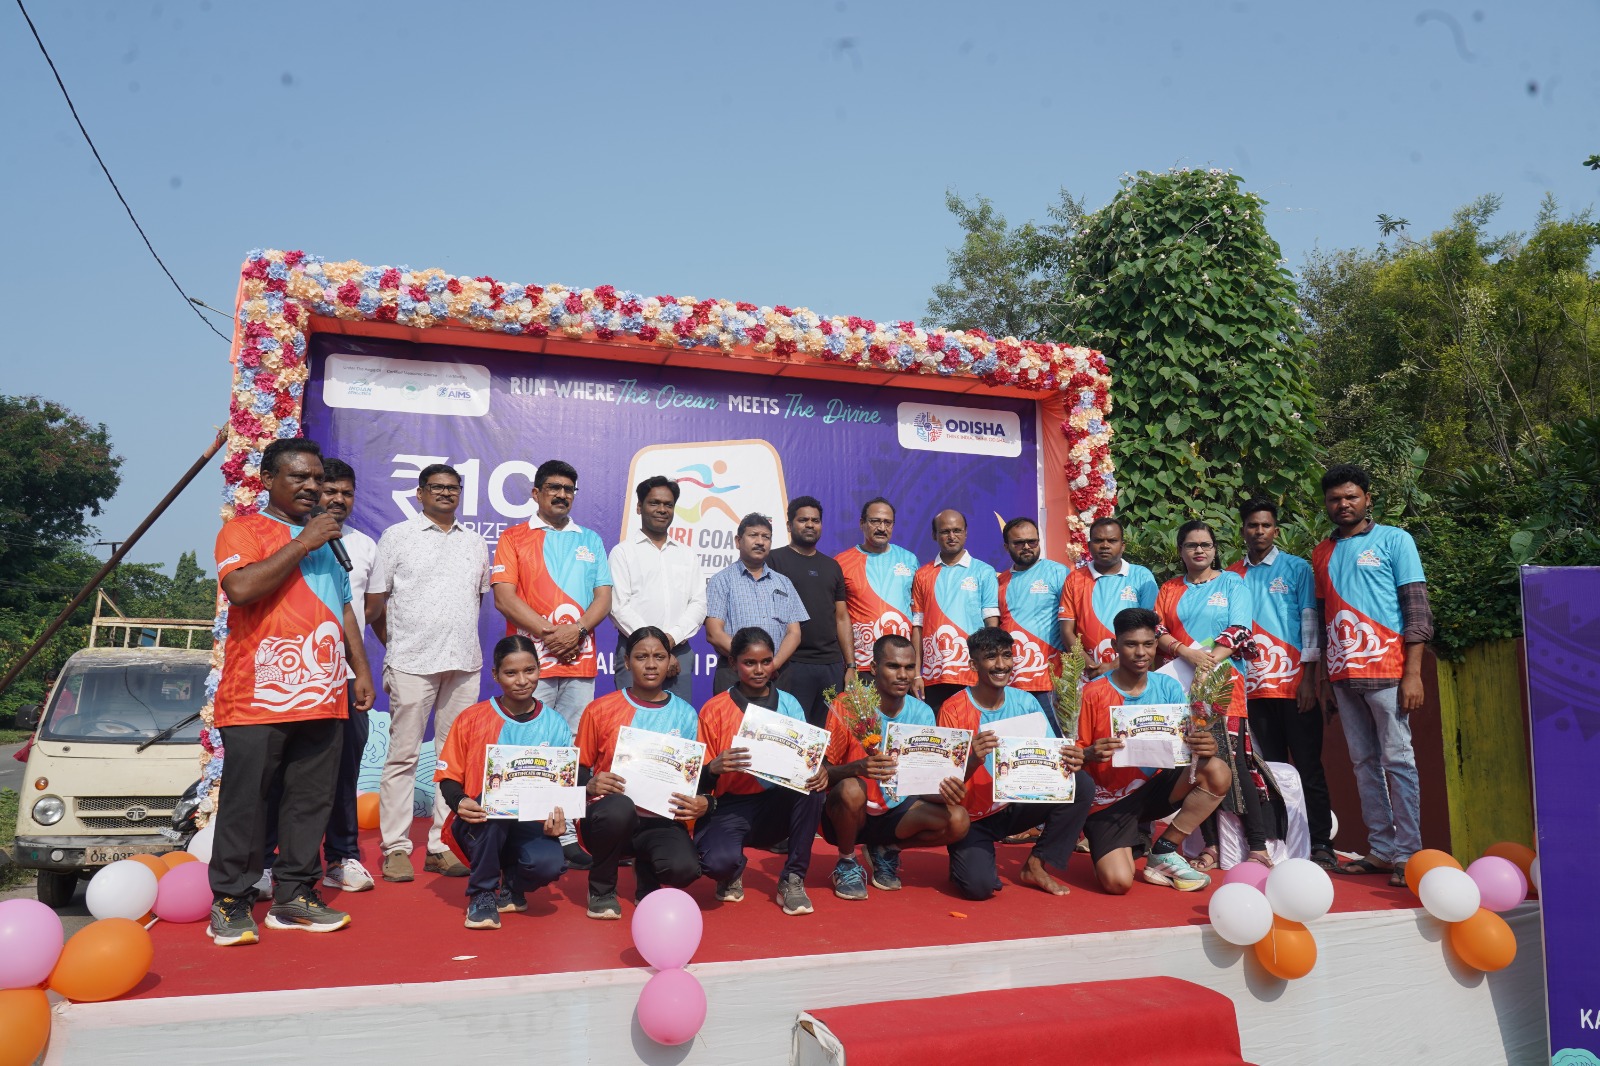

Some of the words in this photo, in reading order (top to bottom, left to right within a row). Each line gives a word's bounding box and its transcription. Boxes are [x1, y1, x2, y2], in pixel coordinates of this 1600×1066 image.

[448, 390, 471, 399] AIMS
[510, 376, 547, 397] RUN
[553, 380, 616, 402] WHERE
[616, 378, 651, 406] The
[655, 384, 719, 410] Ocean
[728, 394, 780, 416] MEETS
[783, 393, 816, 419] The
[823, 398, 882, 424] Divine
[945, 419, 1006, 437] ODISHA
[699, 528, 734, 550] COA
[514, 758, 534, 767] PROMO
[91, 852, 135, 863] OR-03
